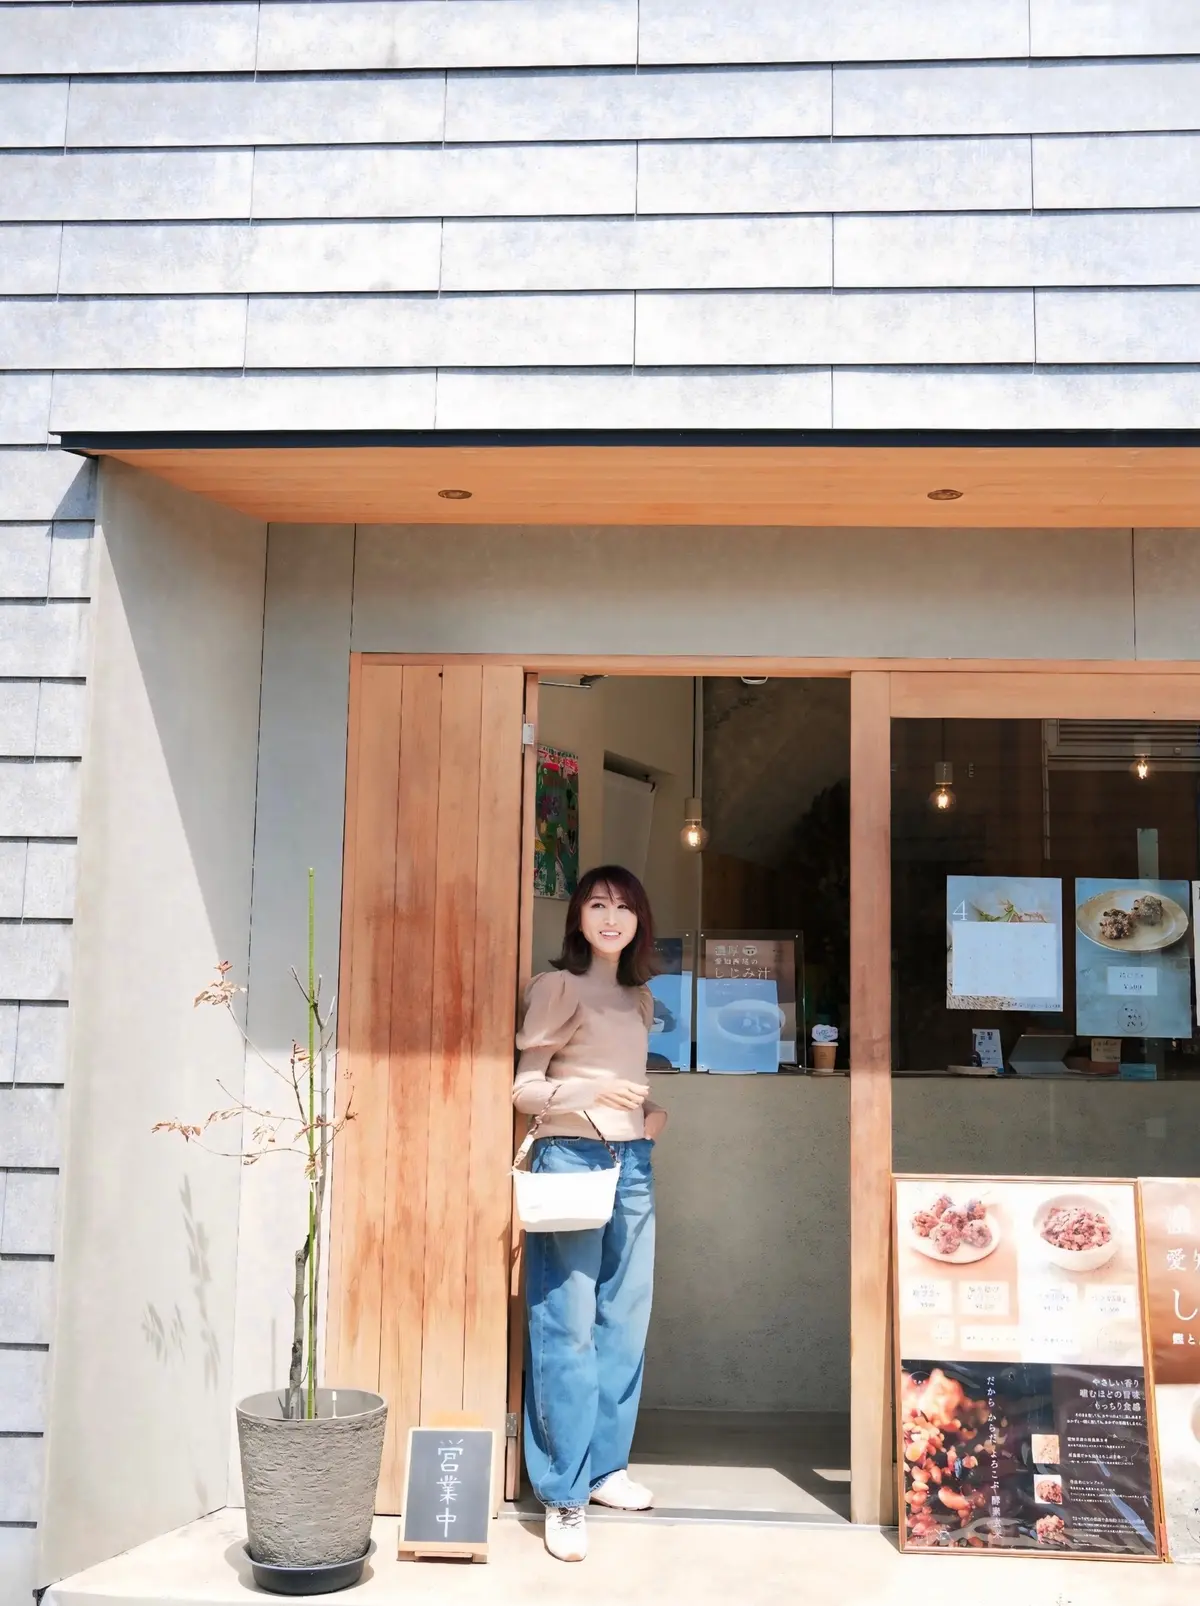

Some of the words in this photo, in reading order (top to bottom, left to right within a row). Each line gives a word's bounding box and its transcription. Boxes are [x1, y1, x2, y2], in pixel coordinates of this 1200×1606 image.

[952, 899, 968, 921] 4
[715, 967, 771, 980] しじみ汁
[986, 1376, 996, 1407] だから
[1092, 1378, 1139, 1388] やさしい香り
[1095, 1401, 1141, 1411] もっちり食感
[435, 1438, 463, 1538] 営業中
